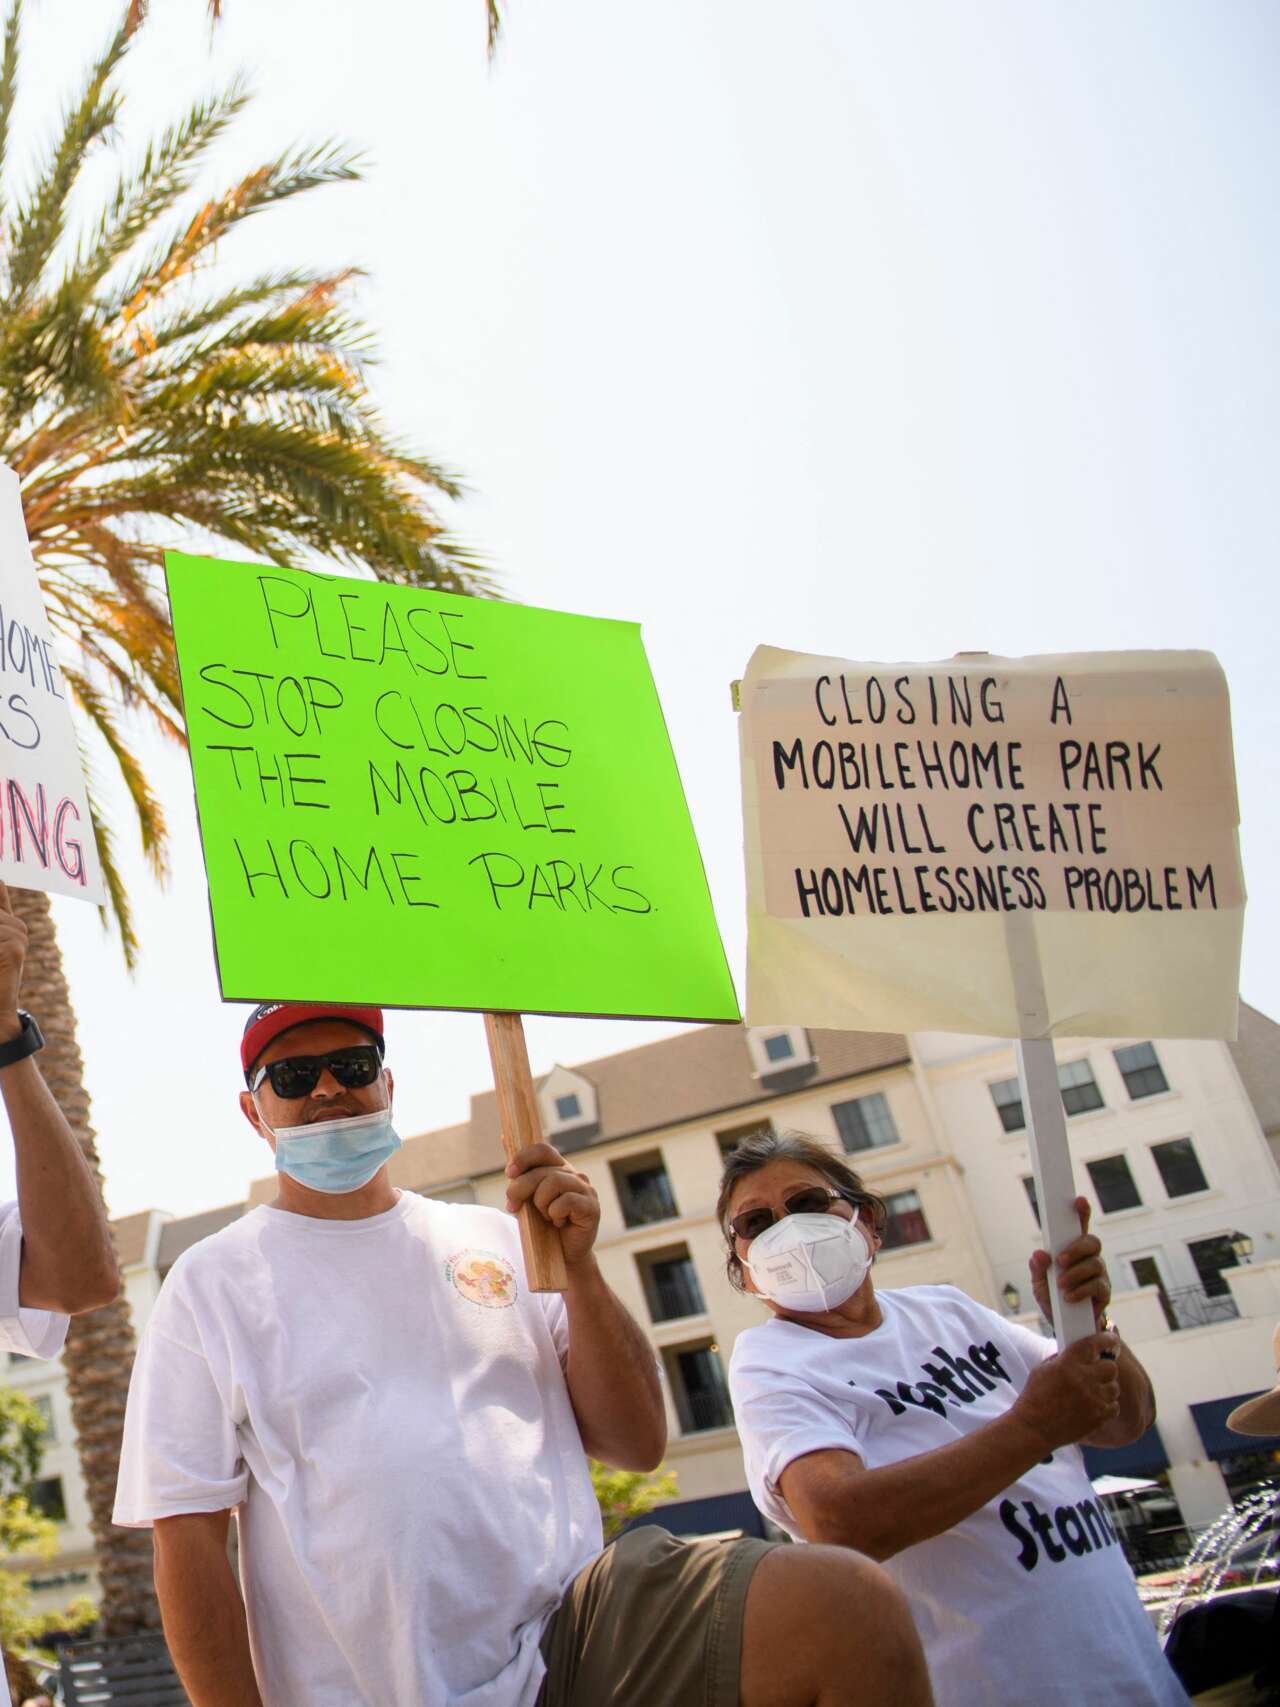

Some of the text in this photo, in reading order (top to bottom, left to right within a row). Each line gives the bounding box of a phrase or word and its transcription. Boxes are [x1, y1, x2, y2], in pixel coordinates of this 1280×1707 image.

[257, 576, 487, 680] PLEASE
[200, 663, 572, 768] STOP CLOSING
[815, 675, 1073, 727] CLOSING A
[206, 744, 576, 833] THE MOBILE
[772, 738, 1164, 792] MOBILEHOME PARK
[838, 803, 1107, 854] WILL CREATE
[234, 838, 439, 908] HOME
[794, 864, 1219, 918] HOMELESSNESS PROBLEM
